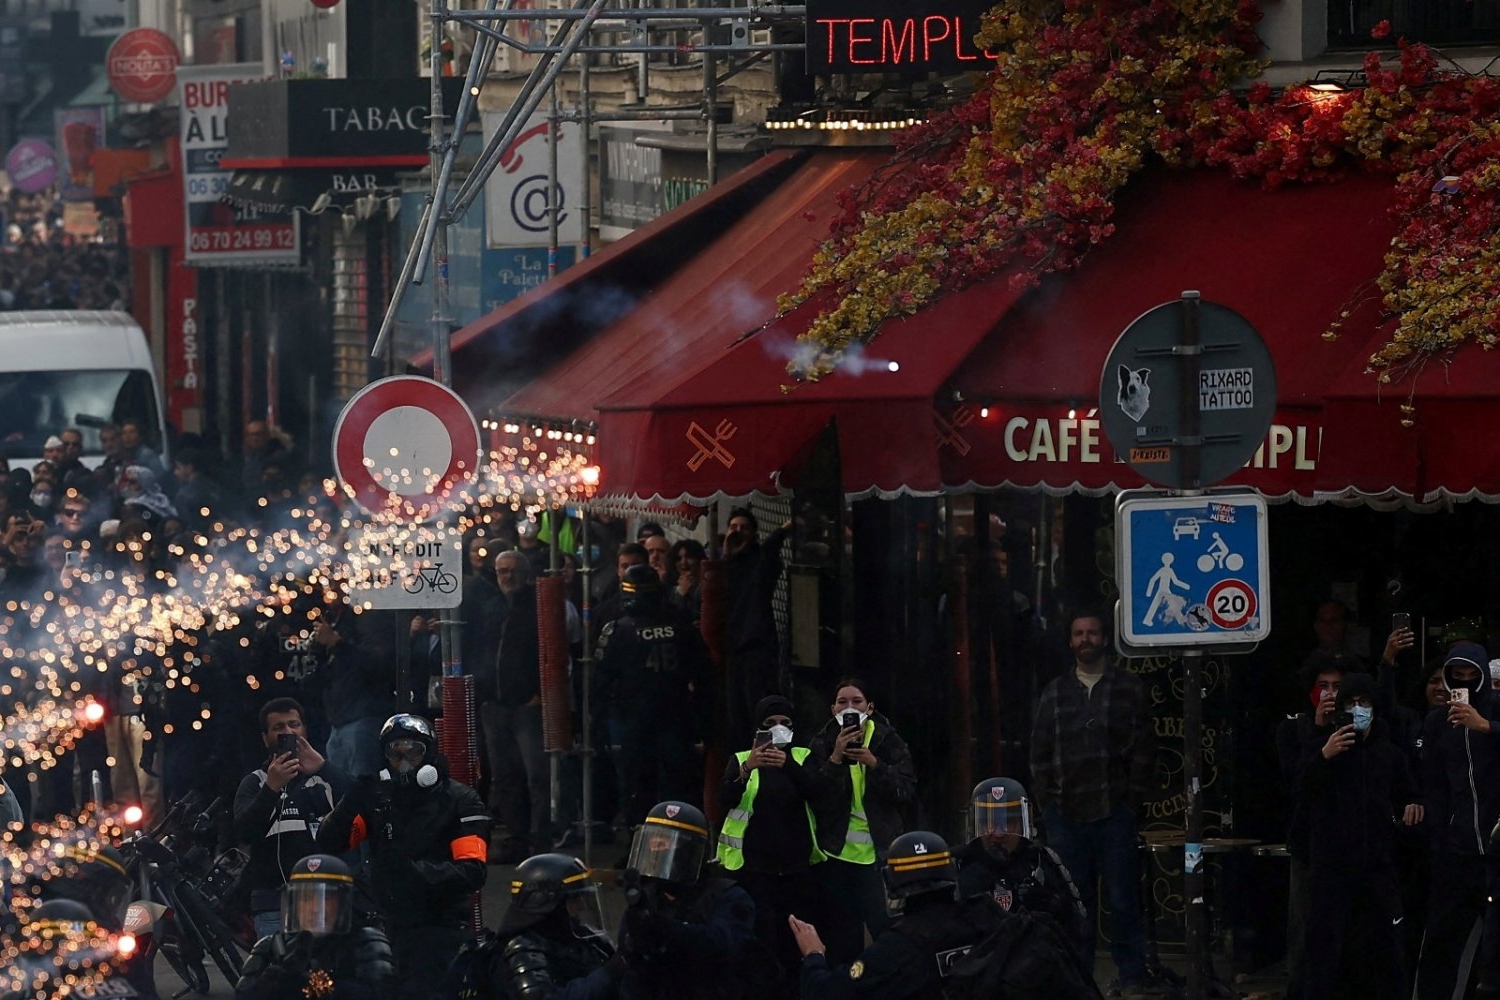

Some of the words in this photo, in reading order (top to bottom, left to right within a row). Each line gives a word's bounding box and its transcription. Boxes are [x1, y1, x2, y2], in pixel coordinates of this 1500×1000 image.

[186, 110, 204, 143] À
[211, 115, 228, 141] L
[322, 105, 428, 132] TABAC
[188, 178, 207, 196] 06
[331, 173, 379, 192] BAR
[191, 233, 210, 251] 06
[212, 231, 230, 250] 70
[233, 231, 251, 249] 24
[254, 230, 272, 248] 99
[274, 229, 292, 247] 12
[514, 255, 542, 271] La
[183, 298, 198, 389] PASTA
[1200, 370, 1252, 388] RIXARD
[1201, 389, 1252, 408] TATTOO
[1003, 407, 1100, 463] CAFÉ
[1244, 425, 1323, 470] PL
[362, 542, 442, 557] NEDIT
[1217, 595, 1245, 614] 20
[641, 625, 675, 640] CRS
[284, 639, 311, 651] CR
[644, 642, 678, 673] 4B
